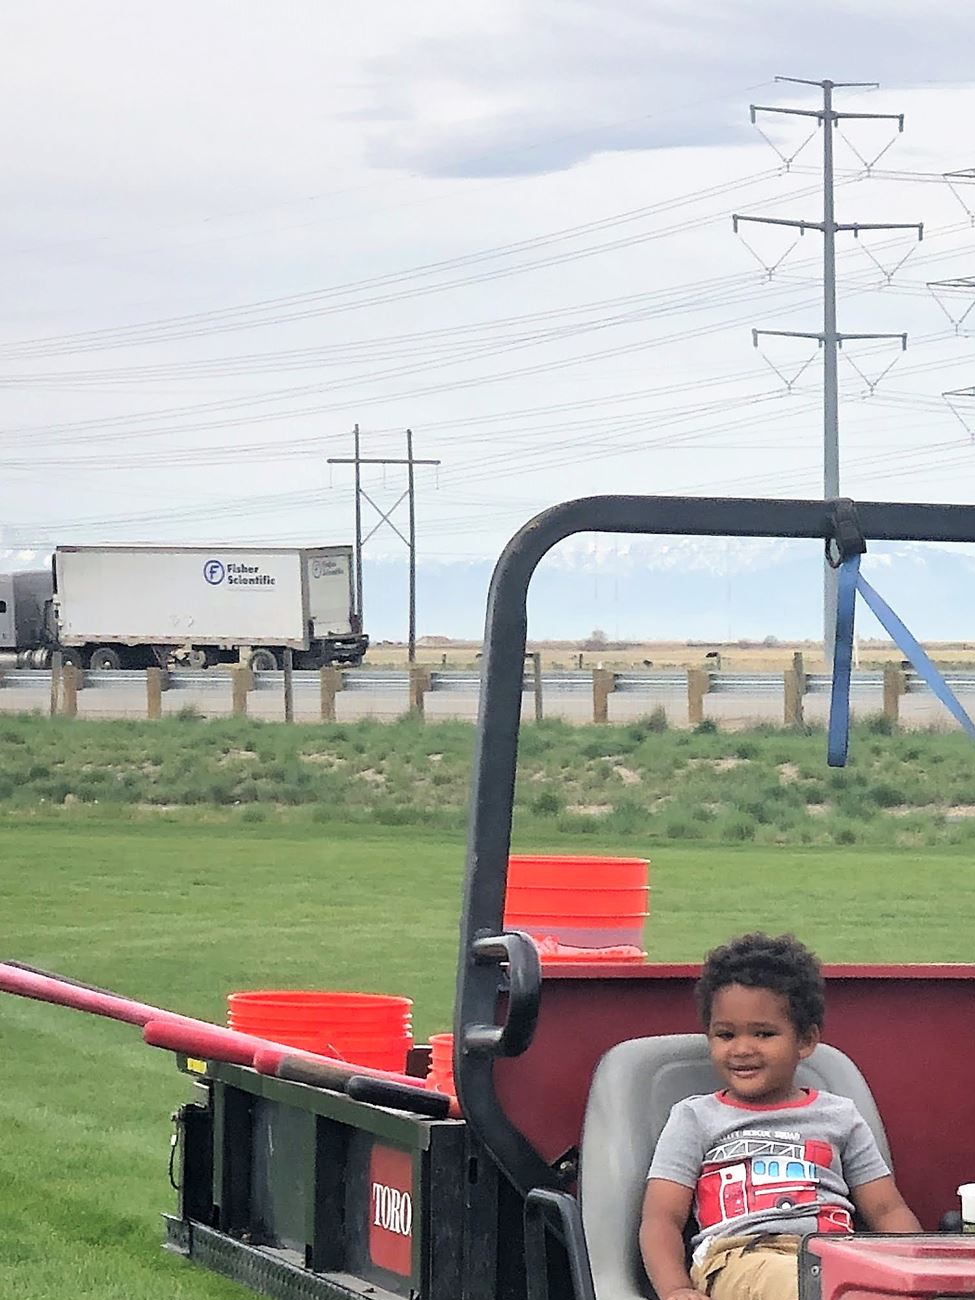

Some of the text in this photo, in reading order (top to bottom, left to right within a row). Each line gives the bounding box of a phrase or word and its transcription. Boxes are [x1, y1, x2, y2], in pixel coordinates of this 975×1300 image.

[227, 564, 259, 574] Fisher
[227, 575, 276, 585] Scientific
[372, 1182, 412, 1237] TORO
